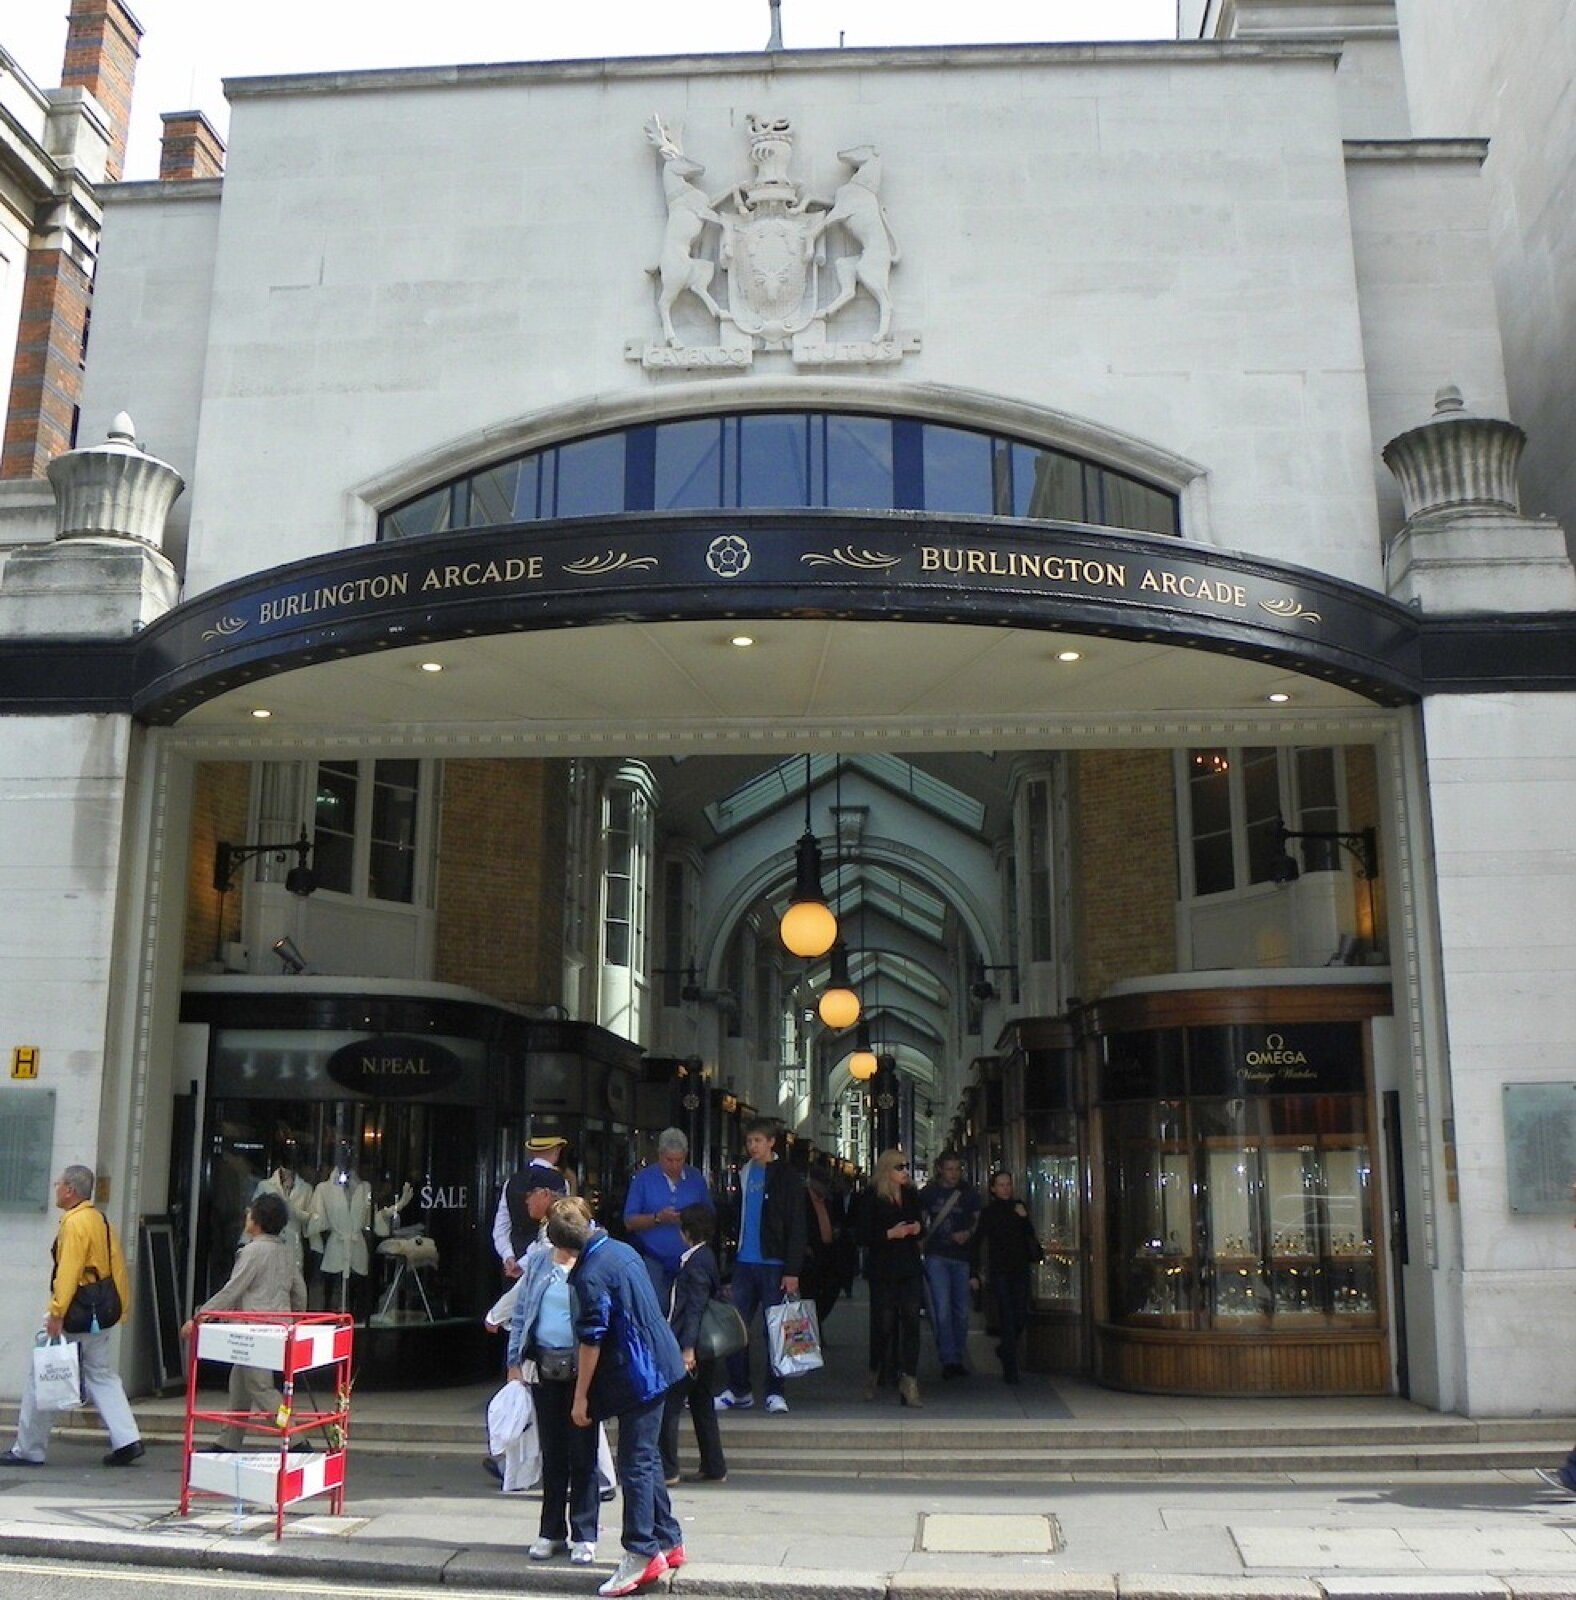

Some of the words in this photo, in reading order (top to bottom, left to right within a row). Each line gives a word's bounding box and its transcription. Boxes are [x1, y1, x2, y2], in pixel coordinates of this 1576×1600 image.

[921, 547, 1126, 587] BURLINGTON
[1140, 569, 1247, 607] ARCADE
[259, 573, 408, 625] BURLINGTON
[422, 556, 544, 591] ARCADE
[16, 1049, 35, 1074] H
[1246, 1051, 1308, 1065] OMEGA
[420, 1186, 467, 1208] SALE
